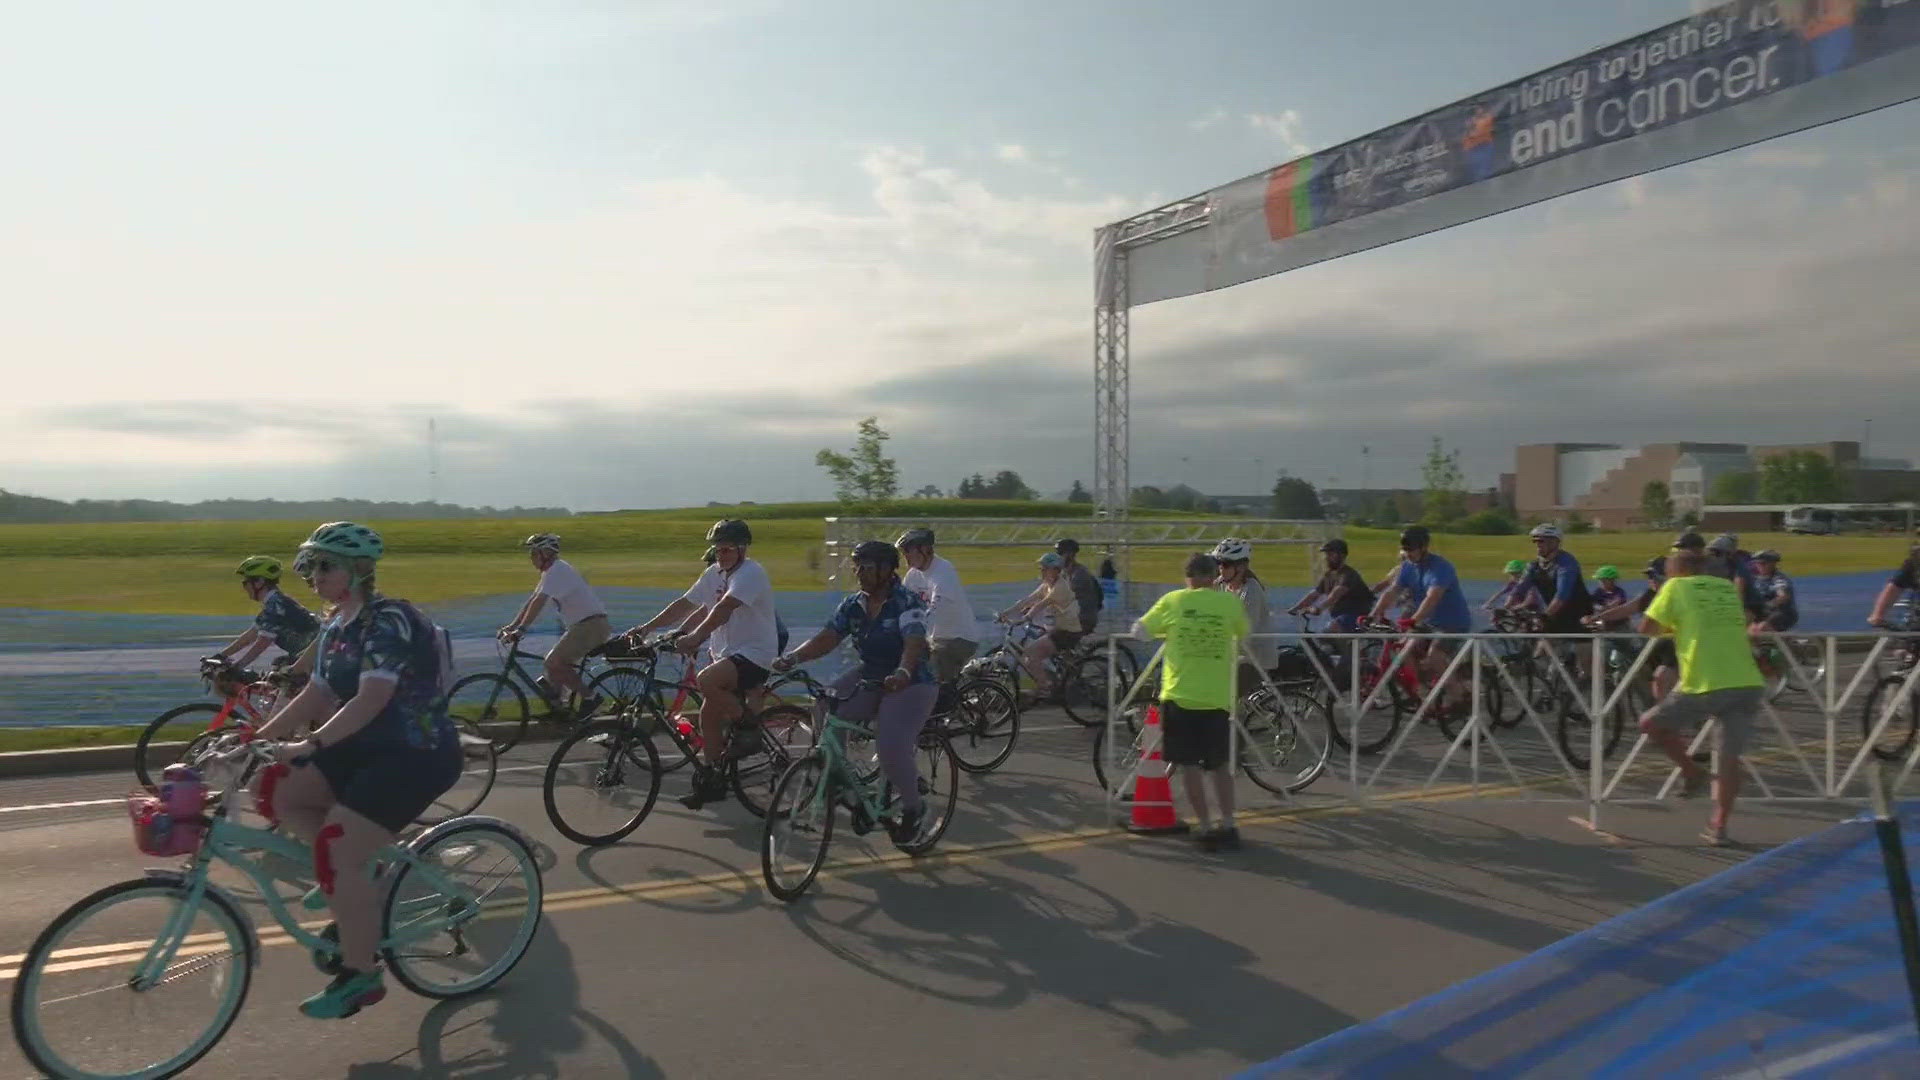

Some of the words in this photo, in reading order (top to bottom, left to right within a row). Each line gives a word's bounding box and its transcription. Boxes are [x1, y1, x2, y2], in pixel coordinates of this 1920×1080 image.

[1599, 17, 1734, 84] together
[1510, 99, 1584, 164] end
[1596, 45, 1780, 138] cancer.
